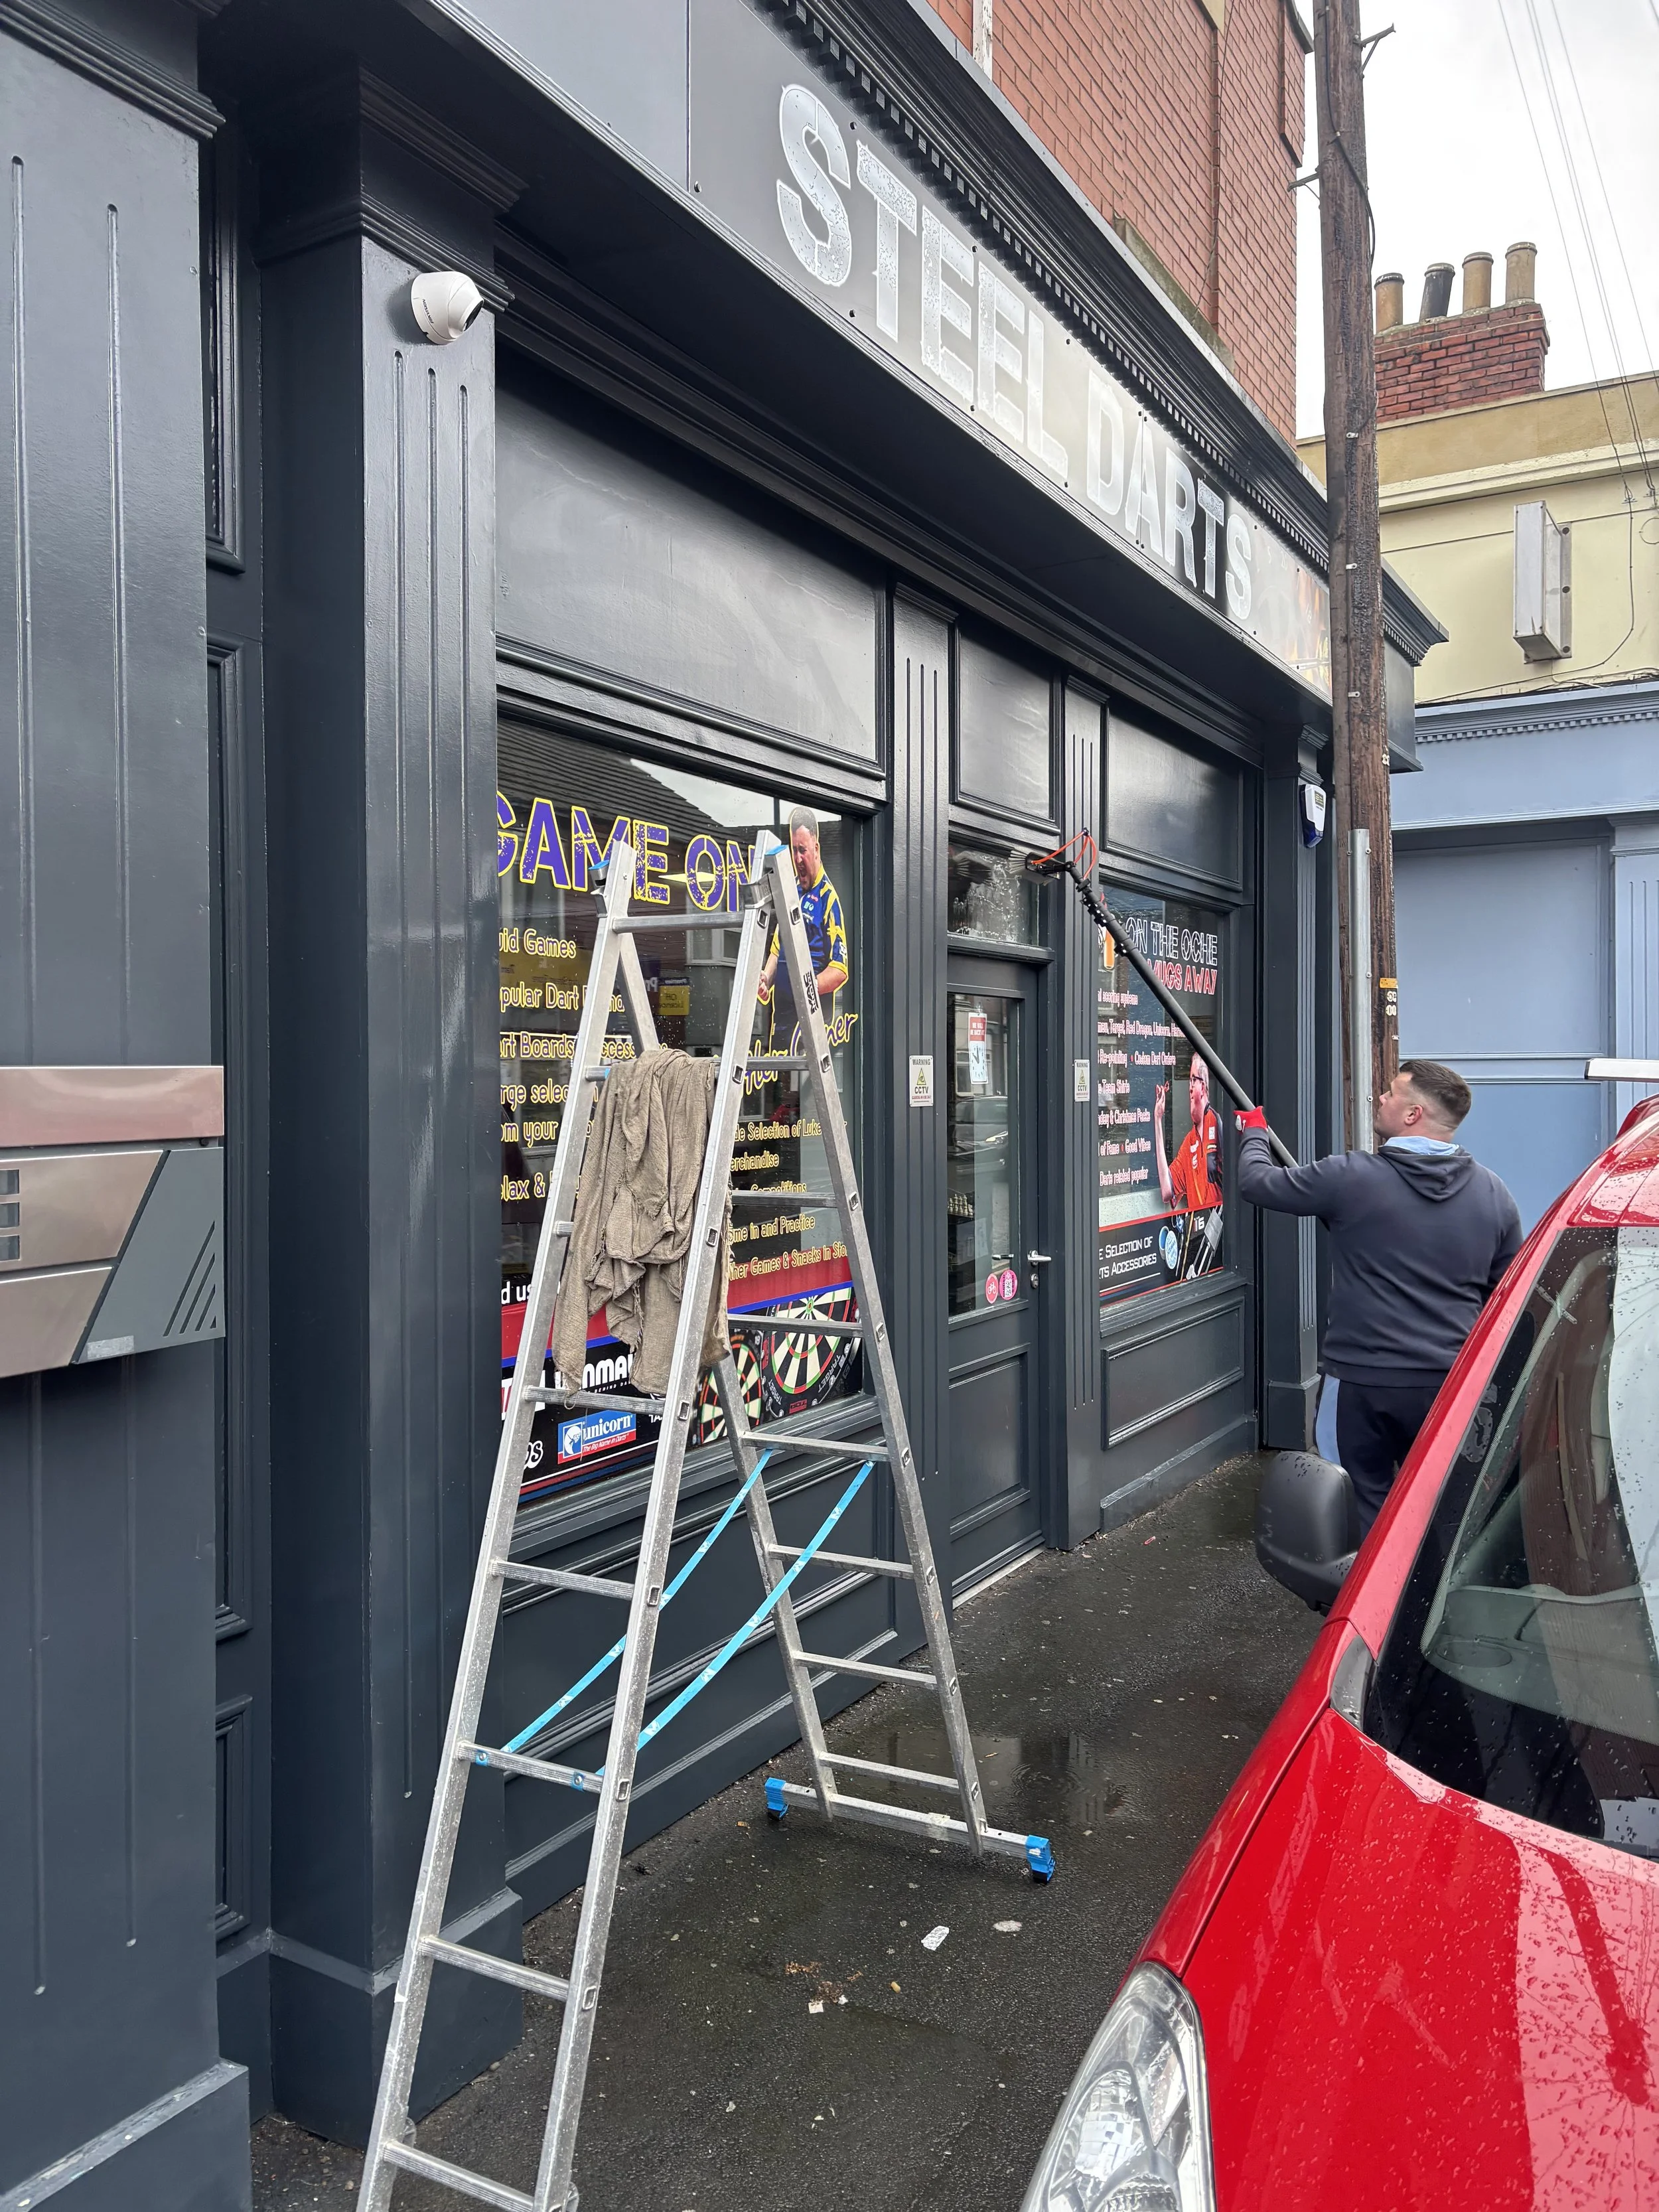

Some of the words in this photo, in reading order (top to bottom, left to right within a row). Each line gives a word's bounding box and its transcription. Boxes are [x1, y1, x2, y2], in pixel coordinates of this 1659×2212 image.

[776, 83, 1068, 480] STEEL
[1086, 370, 1252, 621] DARTS
[496, 790, 670, 905] GAME
[685, 834, 755, 913] ON
[524, 928, 576, 958] Games
[1125, 917, 1147, 954] ON
[1151, 922, 1179, 959] THE
[1181, 929, 1218, 966] OCHE
[1185, 965, 1218, 995] AWAY
[500, 982, 542, 1012] pular
[545, 983, 579, 1010] Dart
[1102, 990, 1119, 1007] scoring
[1120, 990, 1138, 1008] systems
[1109, 1019, 1125, 1038] Target,
[1126, 1019, 1135, 1035] Red
[1136, 1021, 1153, 1039] Dragon,
[520, 1031, 575, 1059] Boards
[1135, 1051, 1150, 1065] Custom
[1151, 1051, 1161, 1065] Dart
[1161, 1052, 1176, 1065] Orders
[500, 1084, 526, 1112] rge
[1102, 1079, 1116, 1094] Team
[1116, 1079, 1129, 1094] Shirts
[748, 1121, 790, 1141] Selection
[791, 1119, 801, 1138] of
[802, 1118, 822, 1137] Luke
[1114, 1109, 1136, 1124] Christmas
[1137, 1108, 1150, 1122] Packs
[524, 1120, 559, 1148] your
[1100, 1141, 1106, 1156] of
[1106, 1140, 1119, 1155] Fame
[1125, 1139, 1137, 1153] Good
[1137, 1138, 1151, 1153] Vibes
[730, 1150, 779, 1171] erchandise
[534, 1172, 545, 1198] &
[1100, 1171, 1112, 1186] Darts
[1114, 1168, 1130, 1184] related
[1131, 1166, 1148, 1185] popular
[728, 1228, 748, 1245] ome
[761, 1218, 778, 1237] and
[780, 1214, 815, 1235] Practice
[729, 1262, 748, 1282] ther
[750, 1256, 780, 1276] Games
[782, 1251, 790, 1269] &
[791, 1246, 821, 1268] Snacks
[832, 1242, 847, 1258] Sto
[818, 1355, 841, 1394] TARGET
[768, 1378, 783, 1406] TARGET
[583, 1415, 631, 1441] unicorn
[597, 1440, 611, 1449] Name
